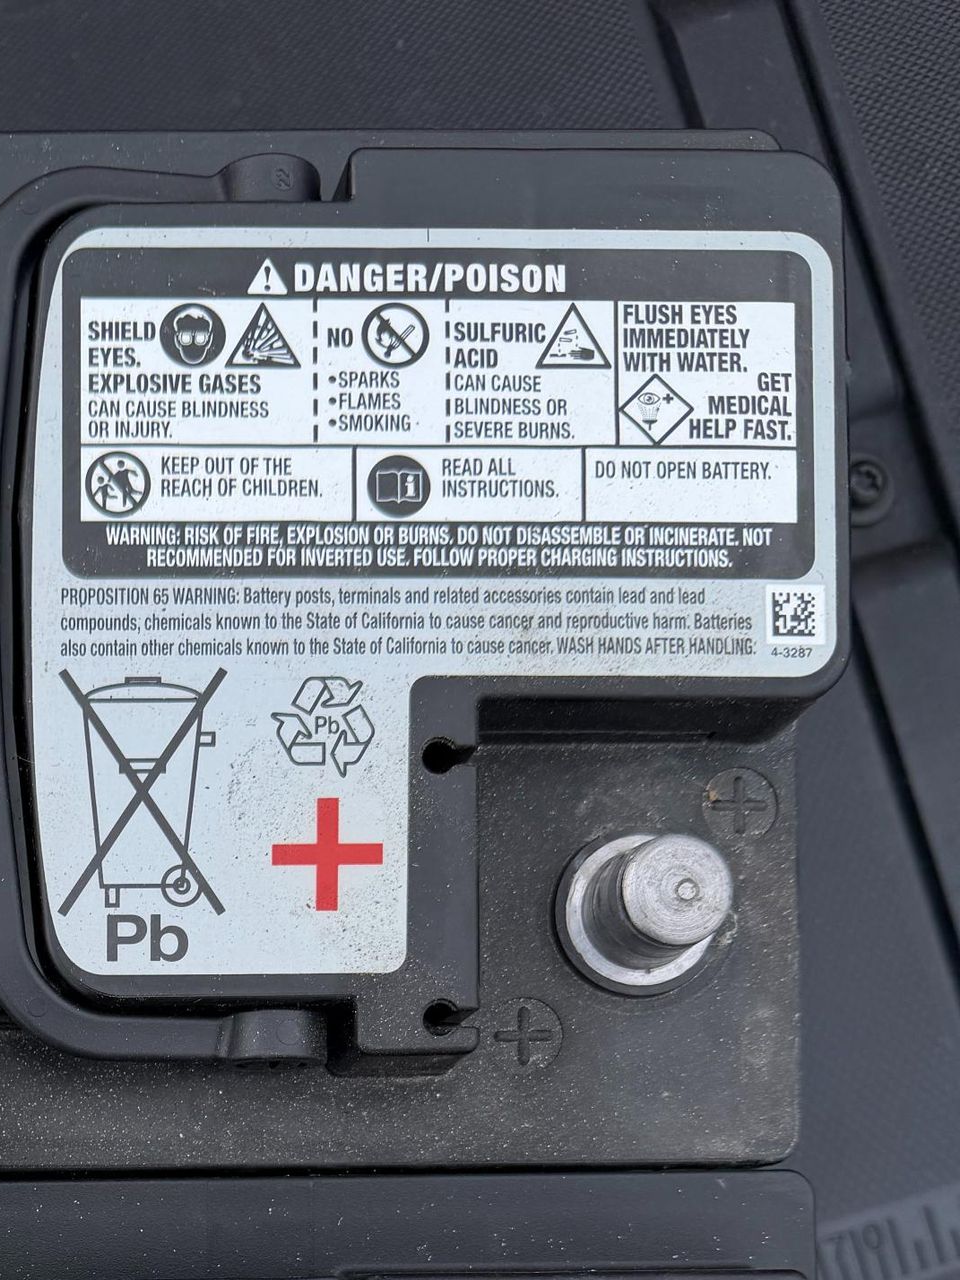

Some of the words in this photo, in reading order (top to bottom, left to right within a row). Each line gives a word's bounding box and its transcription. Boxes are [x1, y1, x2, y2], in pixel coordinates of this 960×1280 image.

[294, 263, 566, 293] DANGER/POISON
[623, 304, 683, 325] FLUSH
[691, 304, 737, 324] EYES
[88, 321, 156, 341] SHIELD
[454, 322, 546, 343] SULFURIC
[623, 328, 750, 348] IMMEDIATELY
[89, 347, 141, 368] EYES.
[454, 349, 498, 369] ACID
[624, 353, 671, 372] WITH
[678, 353, 747, 372] WATER.
[89, 374, 192, 394] EXPLOSIVE
[199, 374, 261, 393] GASES
[758, 373, 792, 392] GET
[708, 396, 792, 416] MEDICAL
[689, 420, 736, 439] HELP
[743, 420, 792, 440] FAST.
[595, 462, 616, 479] DO
[621, 462, 651, 479] NOT
[657, 462, 697, 479] OPEN
[702, 462, 771, 479] BATTERY.
[61, 588, 149, 607] PROPOSITION
[154, 588, 169, 605] 65
[173, 587, 240, 605] WARNING:
[771, 647, 813, 658] 4-3287
[315, 716, 339, 734] Pb
[106, 914, 189, 962] Pb
